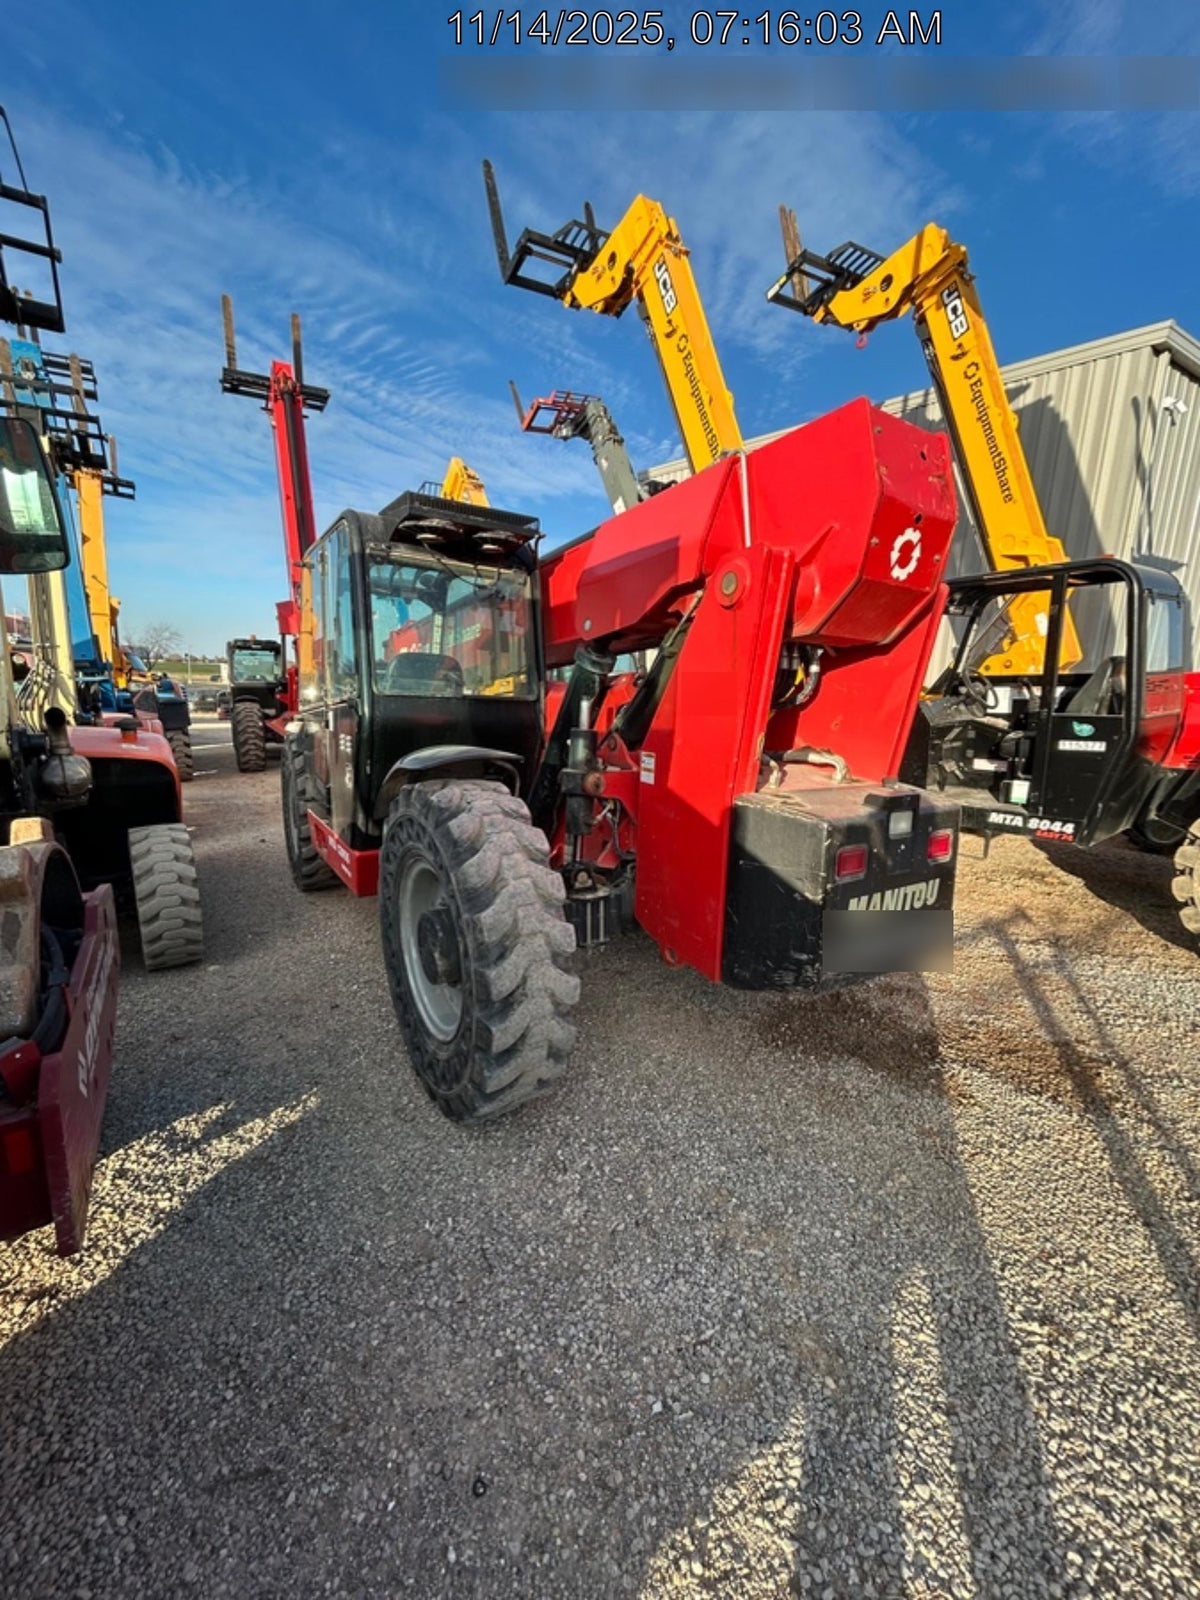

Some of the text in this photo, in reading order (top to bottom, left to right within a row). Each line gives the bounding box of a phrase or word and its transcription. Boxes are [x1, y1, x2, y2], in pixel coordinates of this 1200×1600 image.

[654, 262, 677, 314] JCB
[942, 287, 968, 339] JCB
[681, 353, 721, 461] EquipmentSh
[969, 377, 1015, 504] EquipmentShare
[988, 812, 1075, 835] MTA 8044
